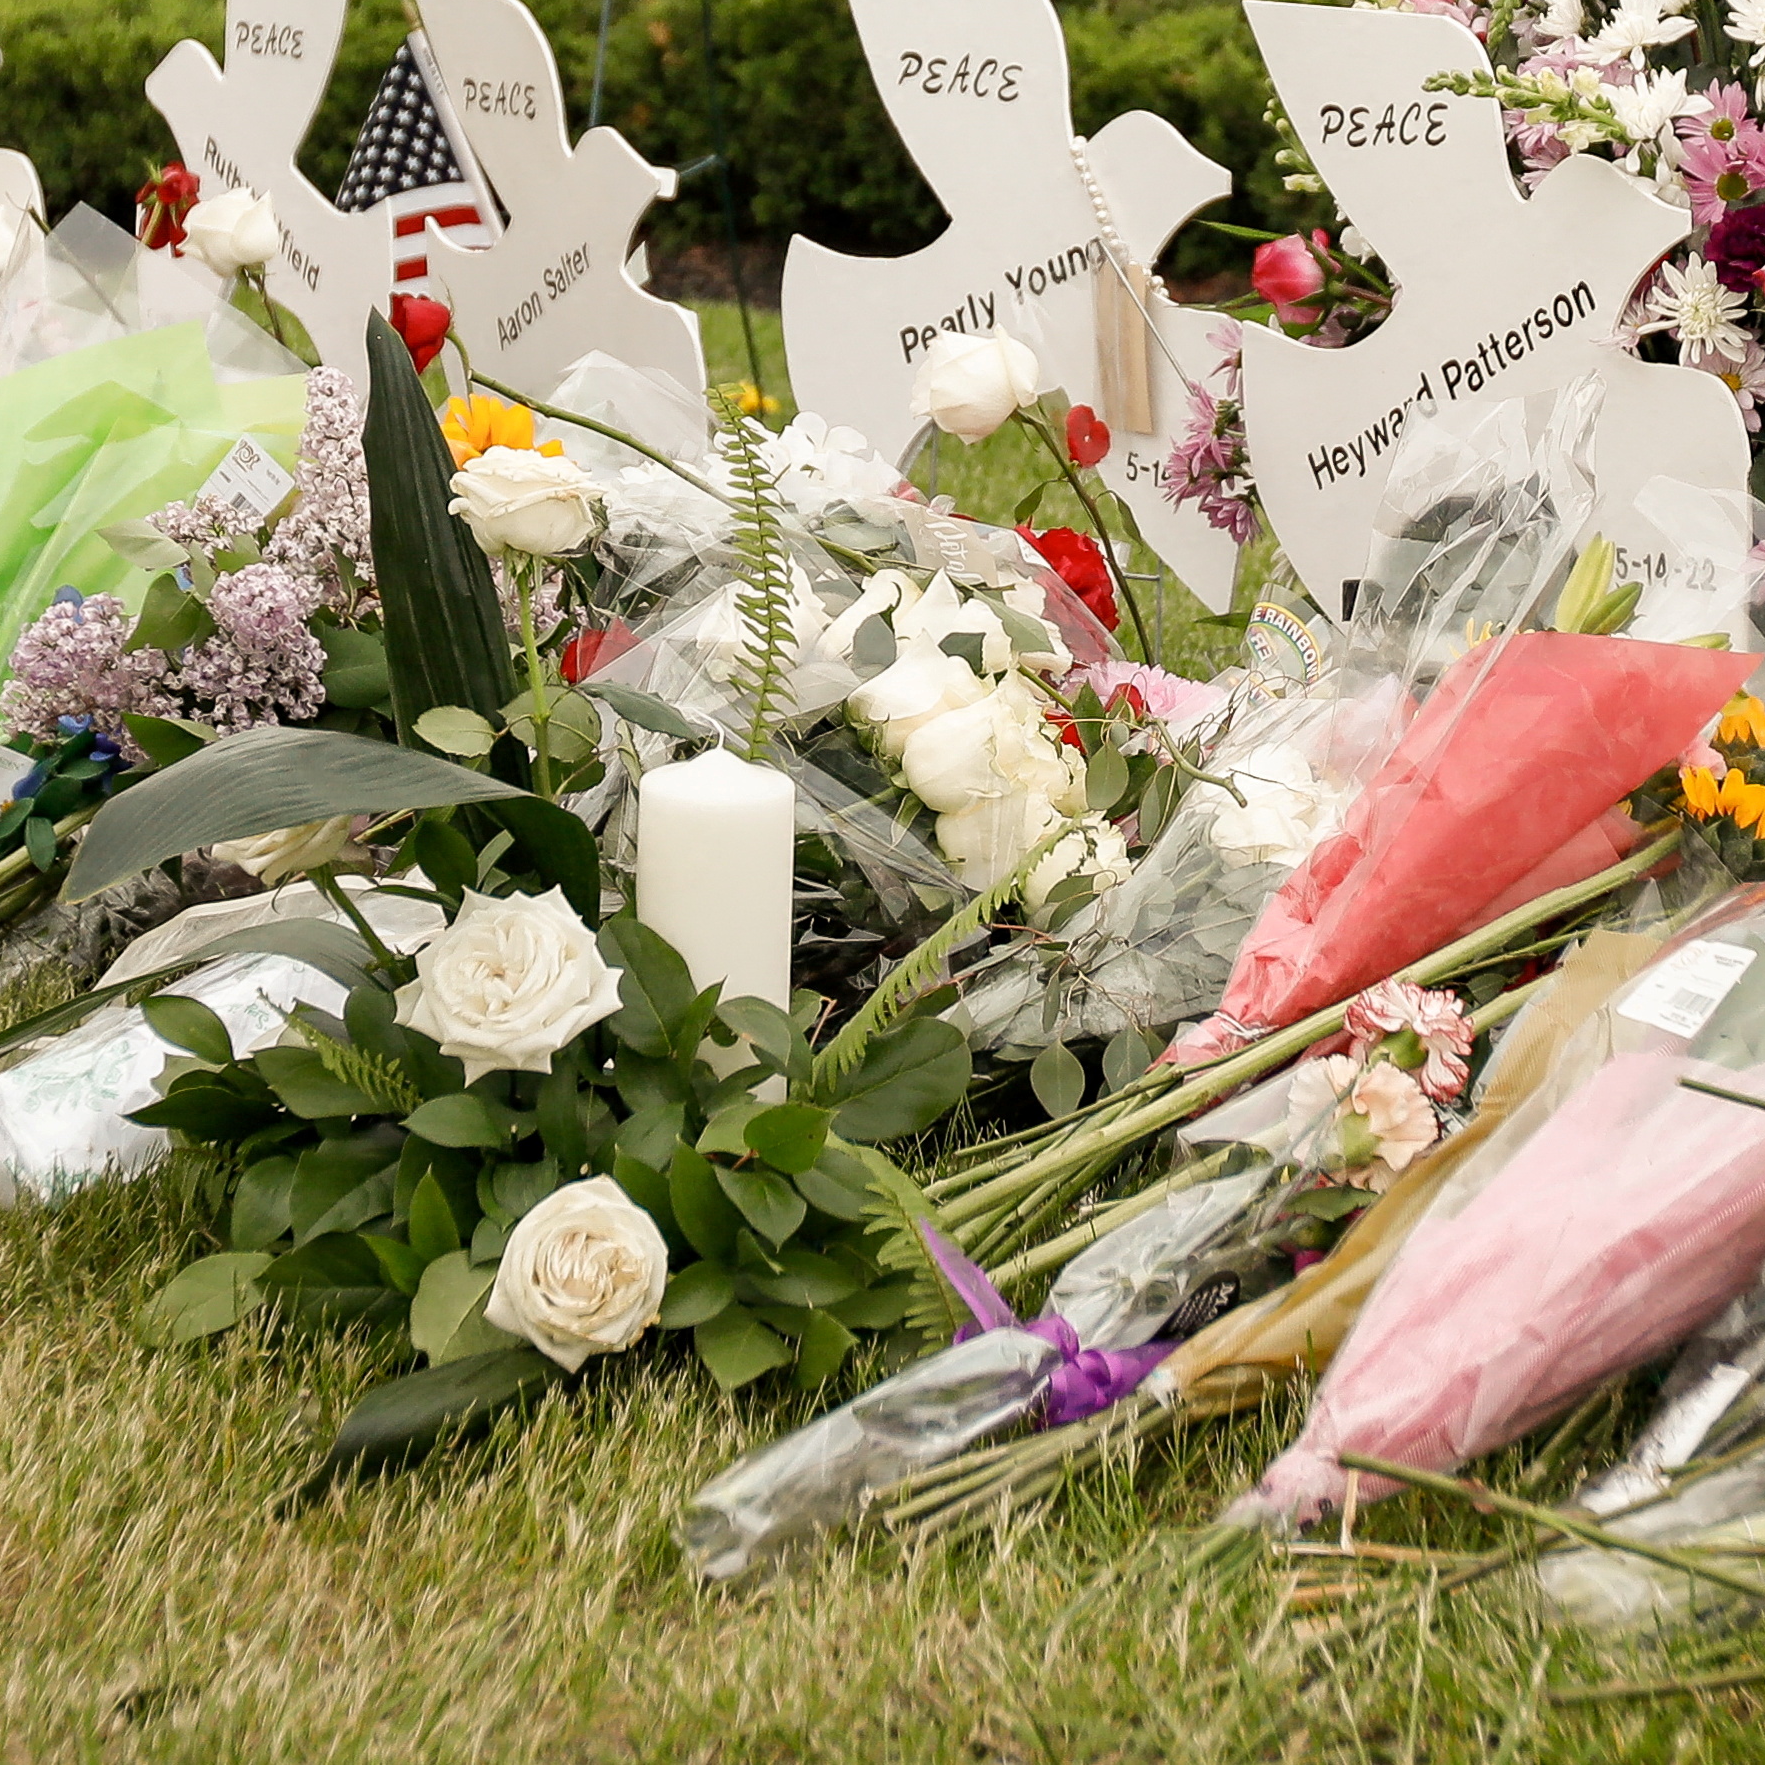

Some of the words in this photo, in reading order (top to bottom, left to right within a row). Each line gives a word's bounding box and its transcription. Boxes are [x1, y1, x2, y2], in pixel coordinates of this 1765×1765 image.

[235, 20, 304, 60] PEACE
[463, 77, 537, 121] PEACE
[897, 51, 1022, 102] PEACE
[1320, 101, 1449, 148] PEACE
[203, 133, 242, 191] Ruth
[498, 298, 543, 351] Aaron
[543, 241, 592, 300] Salter
[899, 291, 996, 365] Pearly
[1440, 280, 1597, 401] Patterson
[1615, 547, 1718, 593] 5-14-22
